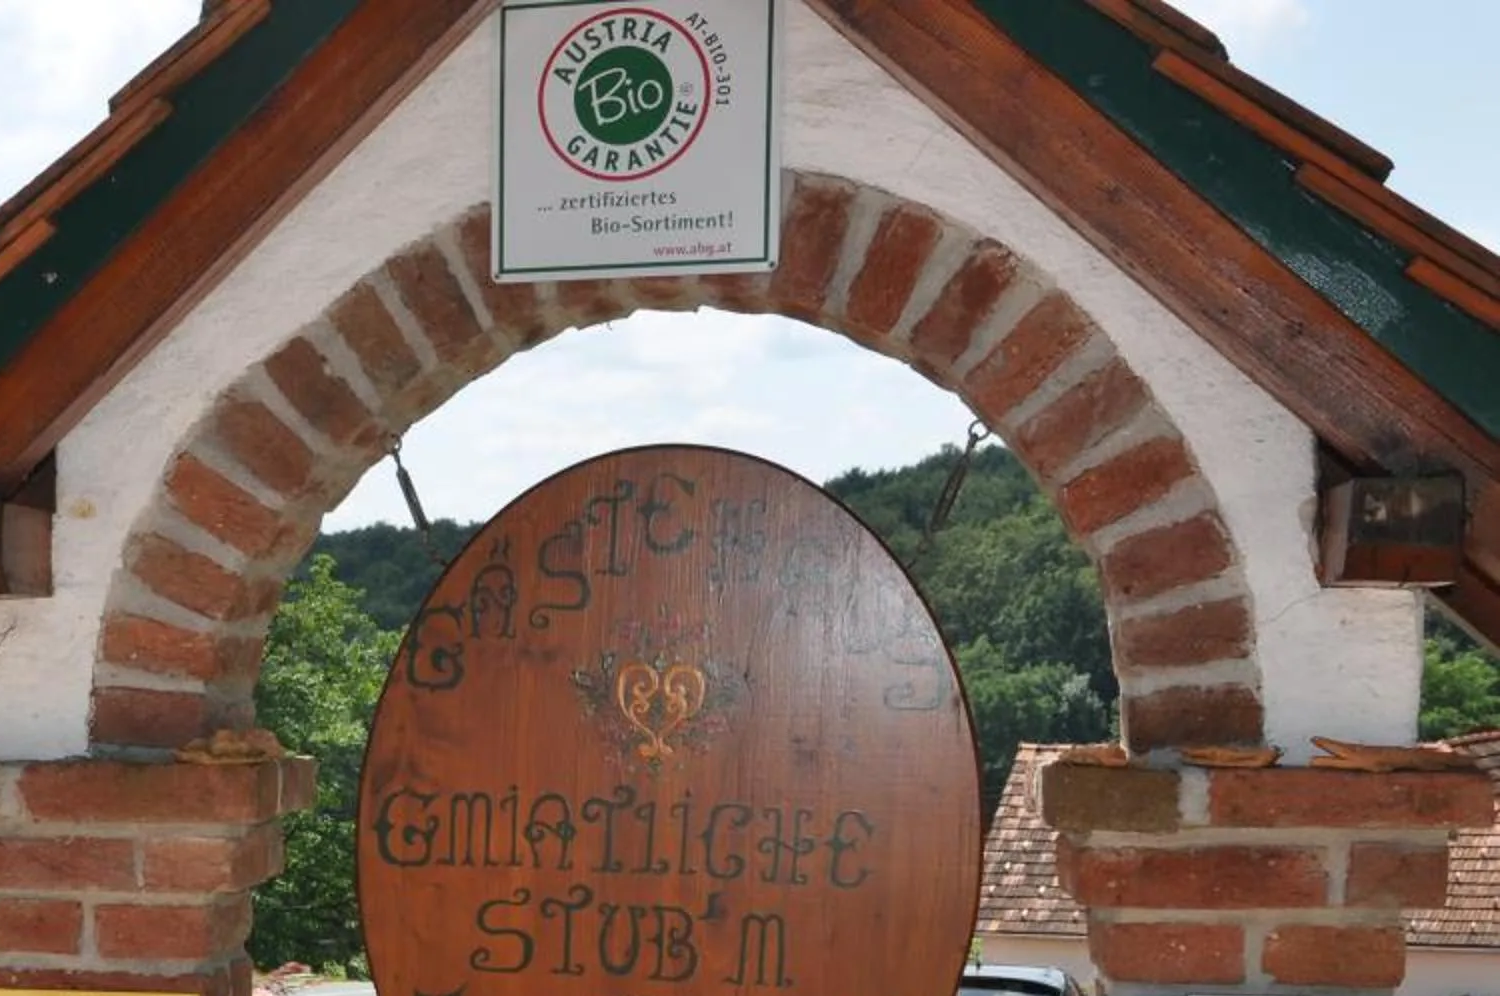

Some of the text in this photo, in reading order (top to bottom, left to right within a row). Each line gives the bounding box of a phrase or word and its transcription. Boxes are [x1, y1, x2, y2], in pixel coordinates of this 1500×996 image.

[553, 17, 672, 85] AUSTRIA
[685, 12, 731, 106] AT-BIO-301
[578, 67, 663, 126] Bio
[567, 101, 697, 171] GARANTIE
[560, 190, 677, 210] zertifiziertes
[591, 211, 734, 235] Bio-Sortiment!
